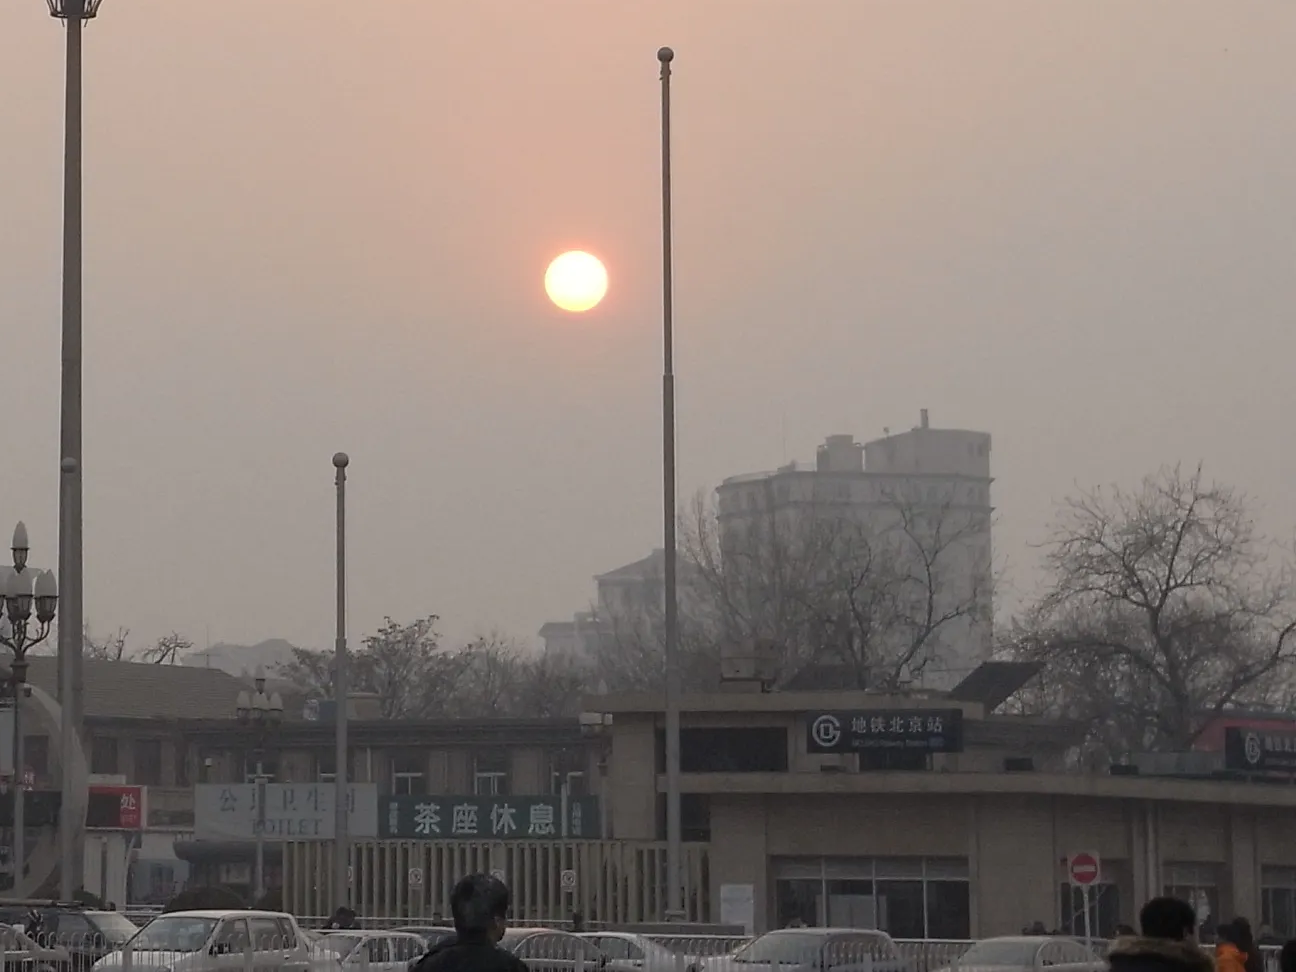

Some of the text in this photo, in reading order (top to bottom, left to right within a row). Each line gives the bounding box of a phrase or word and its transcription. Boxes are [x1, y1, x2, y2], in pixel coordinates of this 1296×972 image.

[851, 716, 942, 733] 地铁北京站
[413, 802, 554, 834] 茶座休息
